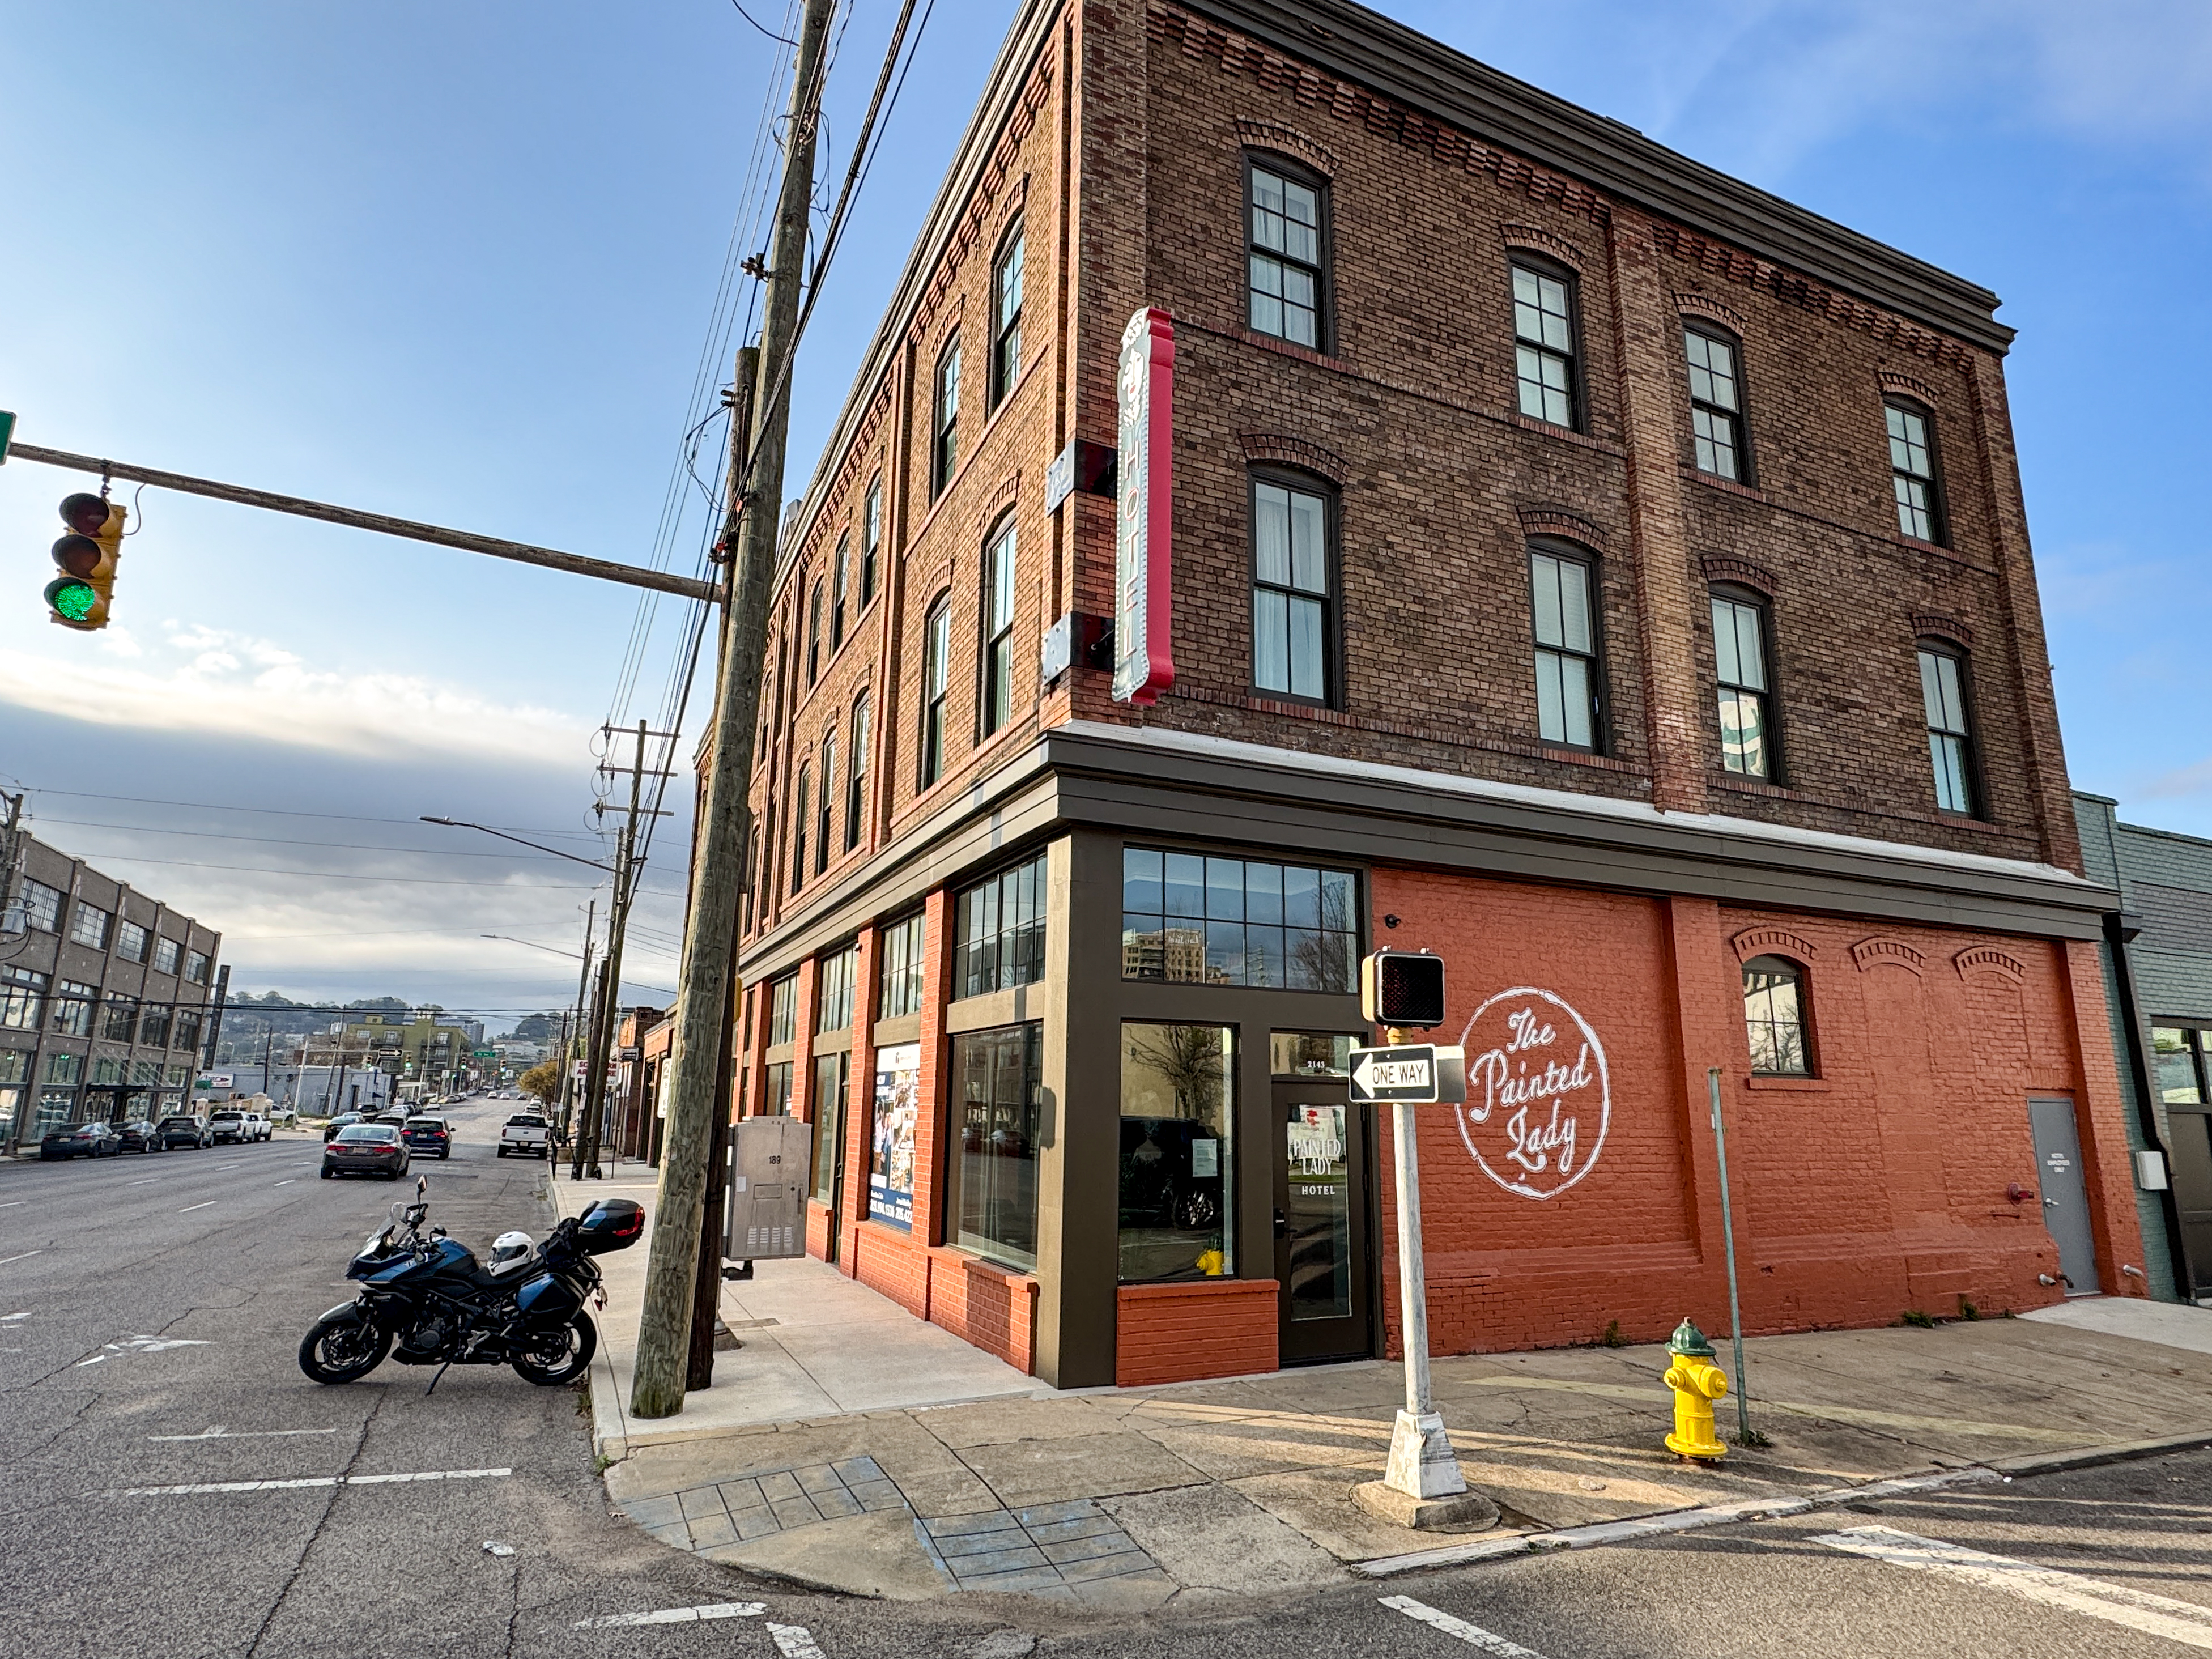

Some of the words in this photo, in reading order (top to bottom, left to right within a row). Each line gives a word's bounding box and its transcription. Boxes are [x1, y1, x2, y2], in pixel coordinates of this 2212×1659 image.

[1124, 439, 1140, 658] HOTEL
[1507, 1007, 1556, 1054] The
[1372, 1065, 1395, 1084] ONE
[1399, 1064, 1424, 1083] WAY
[1468, 1043, 1593, 1123] Painted
[1506, 1097, 1576, 1176] Lady
[1294, 1139, 1341, 1156] PAINTED
[769, 1155, 781, 1165] 189
[1303, 1156, 1332, 1175] LADY
[1301, 1185, 1335, 1195] HOTEL
